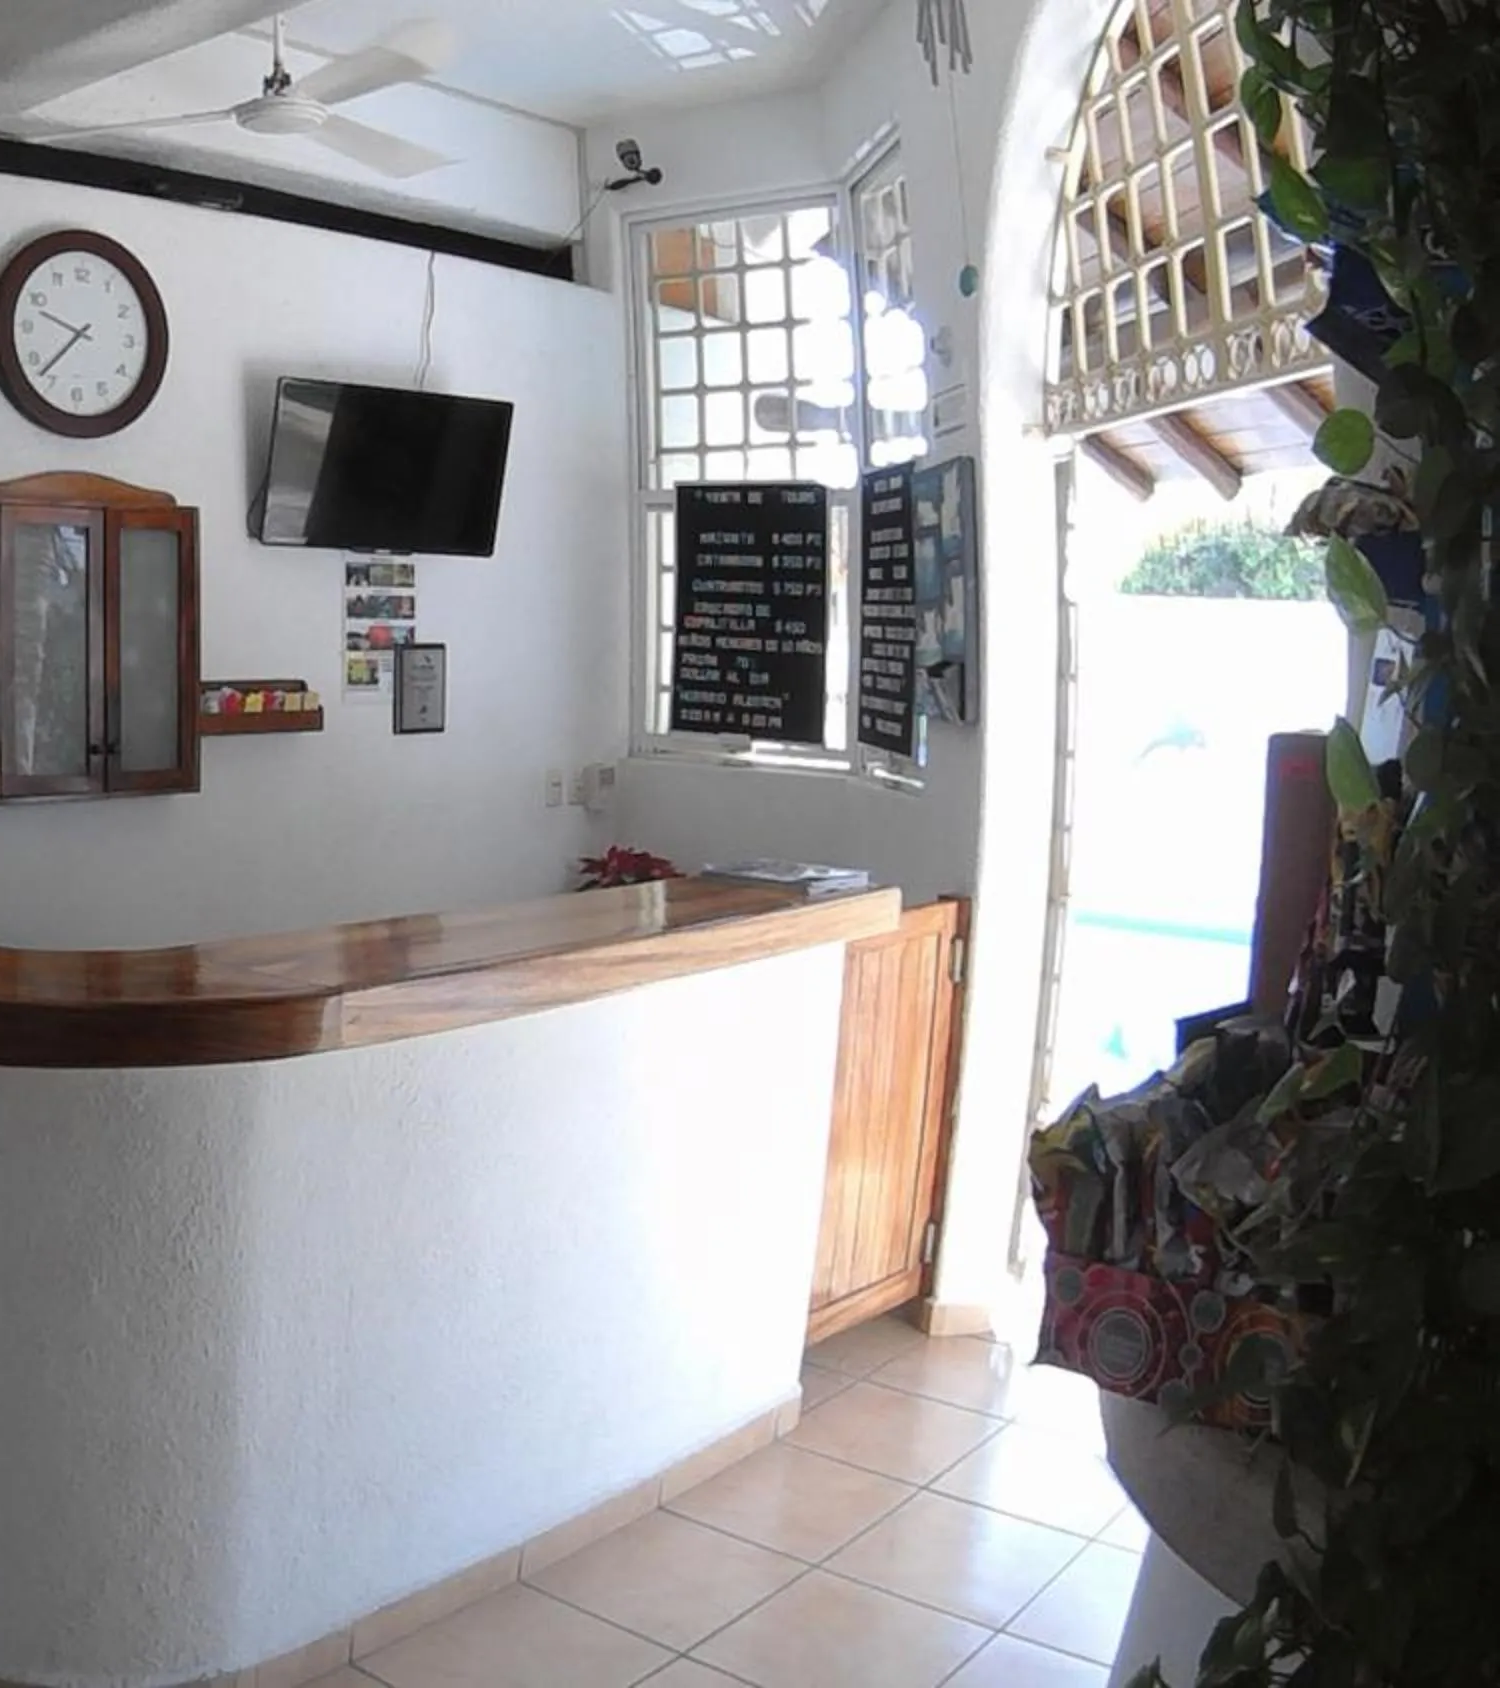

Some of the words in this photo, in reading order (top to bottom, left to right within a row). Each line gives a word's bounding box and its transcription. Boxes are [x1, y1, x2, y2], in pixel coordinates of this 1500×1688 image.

[52, 272, 64, 287] 11
[73, 267, 91, 284] 12
[29, 292, 48, 306] 10
[117, 304, 129, 319] 2
[21, 319, 34, 334] 9
[123, 334, 135, 349] 3
[28, 351, 40, 366] 8
[115, 364, 127, 377] 4
[48, 375, 58, 388] 7
[96, 381, 109, 396] 5
[70, 387, 84, 402] 6
